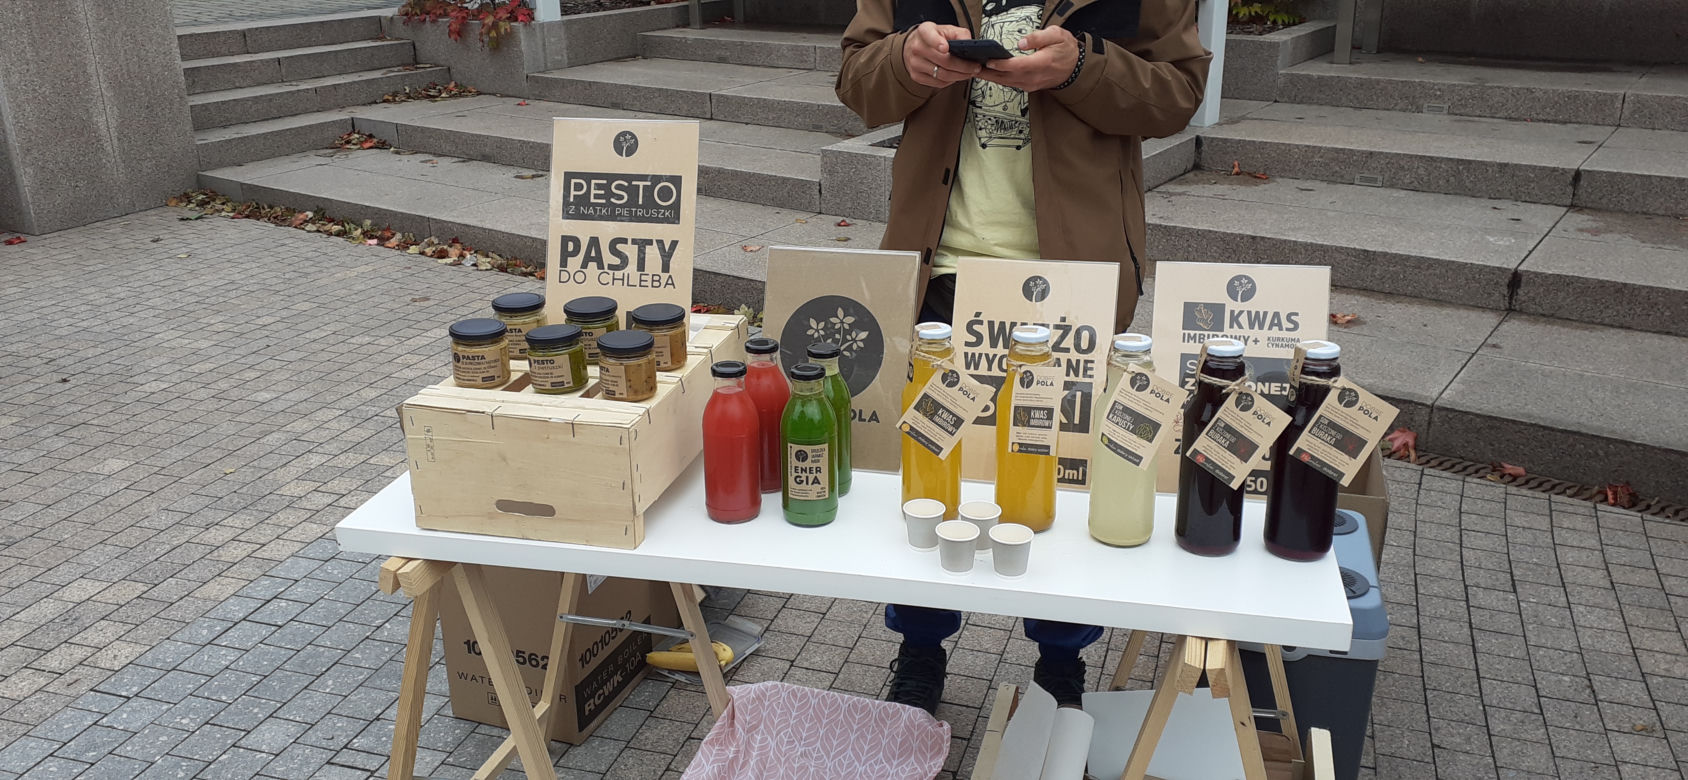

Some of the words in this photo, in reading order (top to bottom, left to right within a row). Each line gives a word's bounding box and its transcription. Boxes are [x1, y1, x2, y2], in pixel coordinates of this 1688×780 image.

[568, 178, 677, 206] PESTO
[568, 206, 576, 214] Z
[580, 206, 611, 216] NATKI
[615, 208, 674, 218] PIETRUSZKI
[559, 234, 680, 274] PASTY
[558, 269, 588, 285] DO
[598, 271, 676, 289] CHLEBA
[1228, 310, 1300, 332] KWAS
[958, 386, 976, 402] POLA
[1150, 389, 1170, 404] POLA
[937, 407, 957, 424] KWAS
[1031, 410, 1048, 419] KWAS
[1252, 410, 1272, 427] POLA
[1357, 405, 1379, 422] POLA
[1108, 414, 1134, 431] KAPUSTY
[1207, 429, 1230, 448] BURAKA
[1311, 426, 1336, 445] BURAKA
[794, 466, 822, 474] ENER
[794, 475, 821, 485] GIA
[457, 672, 494, 687] WATE
